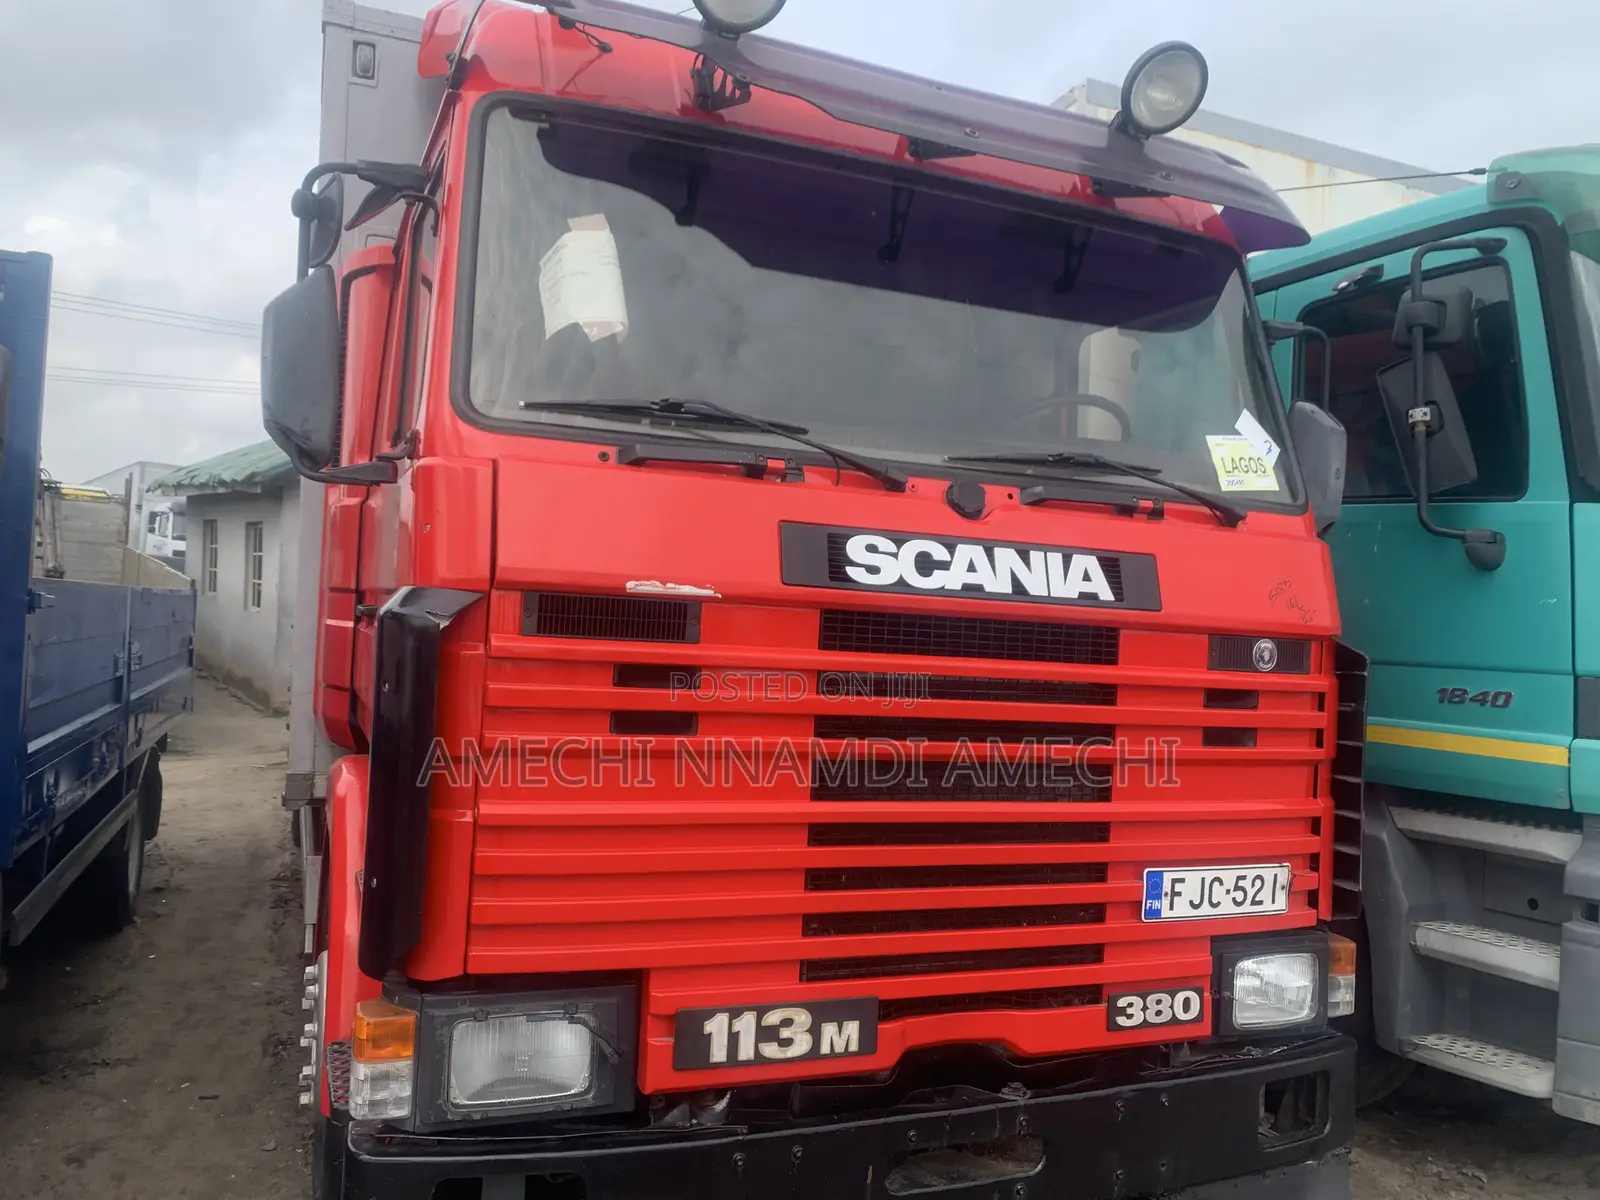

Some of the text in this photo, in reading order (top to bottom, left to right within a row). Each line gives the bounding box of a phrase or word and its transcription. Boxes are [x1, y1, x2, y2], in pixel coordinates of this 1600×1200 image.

[1221, 456, 1267, 474] LAGOS
[844, 534, 1116, 602] SCANIA
[1437, 688, 1513, 708] 1840
[1146, 900, 1161, 911] FIN
[1168, 873, 1278, 911] FJC-521
[1115, 990, 1201, 1027] 380
[703, 1007, 860, 1063] 113 M
